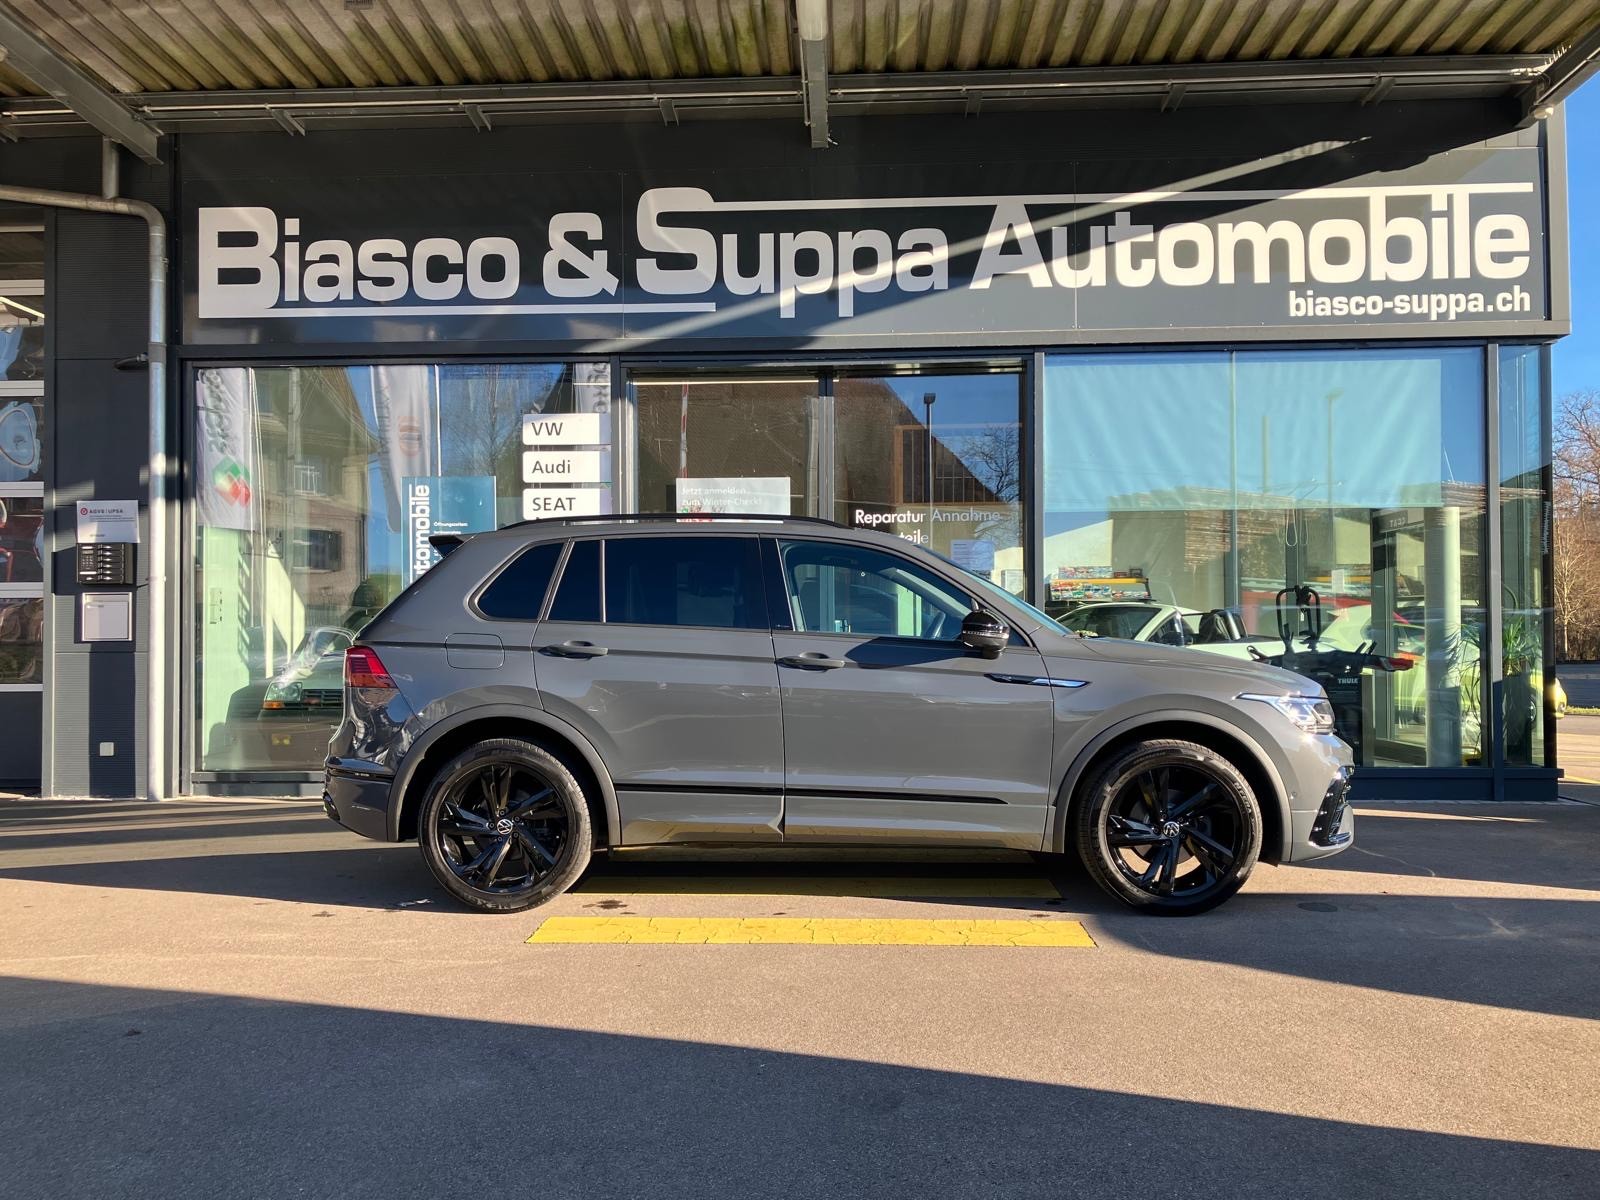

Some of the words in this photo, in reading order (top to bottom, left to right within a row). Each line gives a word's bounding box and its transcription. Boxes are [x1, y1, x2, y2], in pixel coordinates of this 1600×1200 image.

[198, 206, 521, 319] Biasco
[543, 212, 620, 297] &
[636, 187, 950, 319] Suppa
[970, 184, 1532, 291] Automobile
[1289, 286, 1532, 321] biasco-suppa.ch
[531, 422, 563, 436] VW
[531, 459, 571, 474] Audi
[532, 497, 576, 511] SEAT
[855, 509, 926, 527] Reparatur
[931, 507, 1001, 522] Annahme
